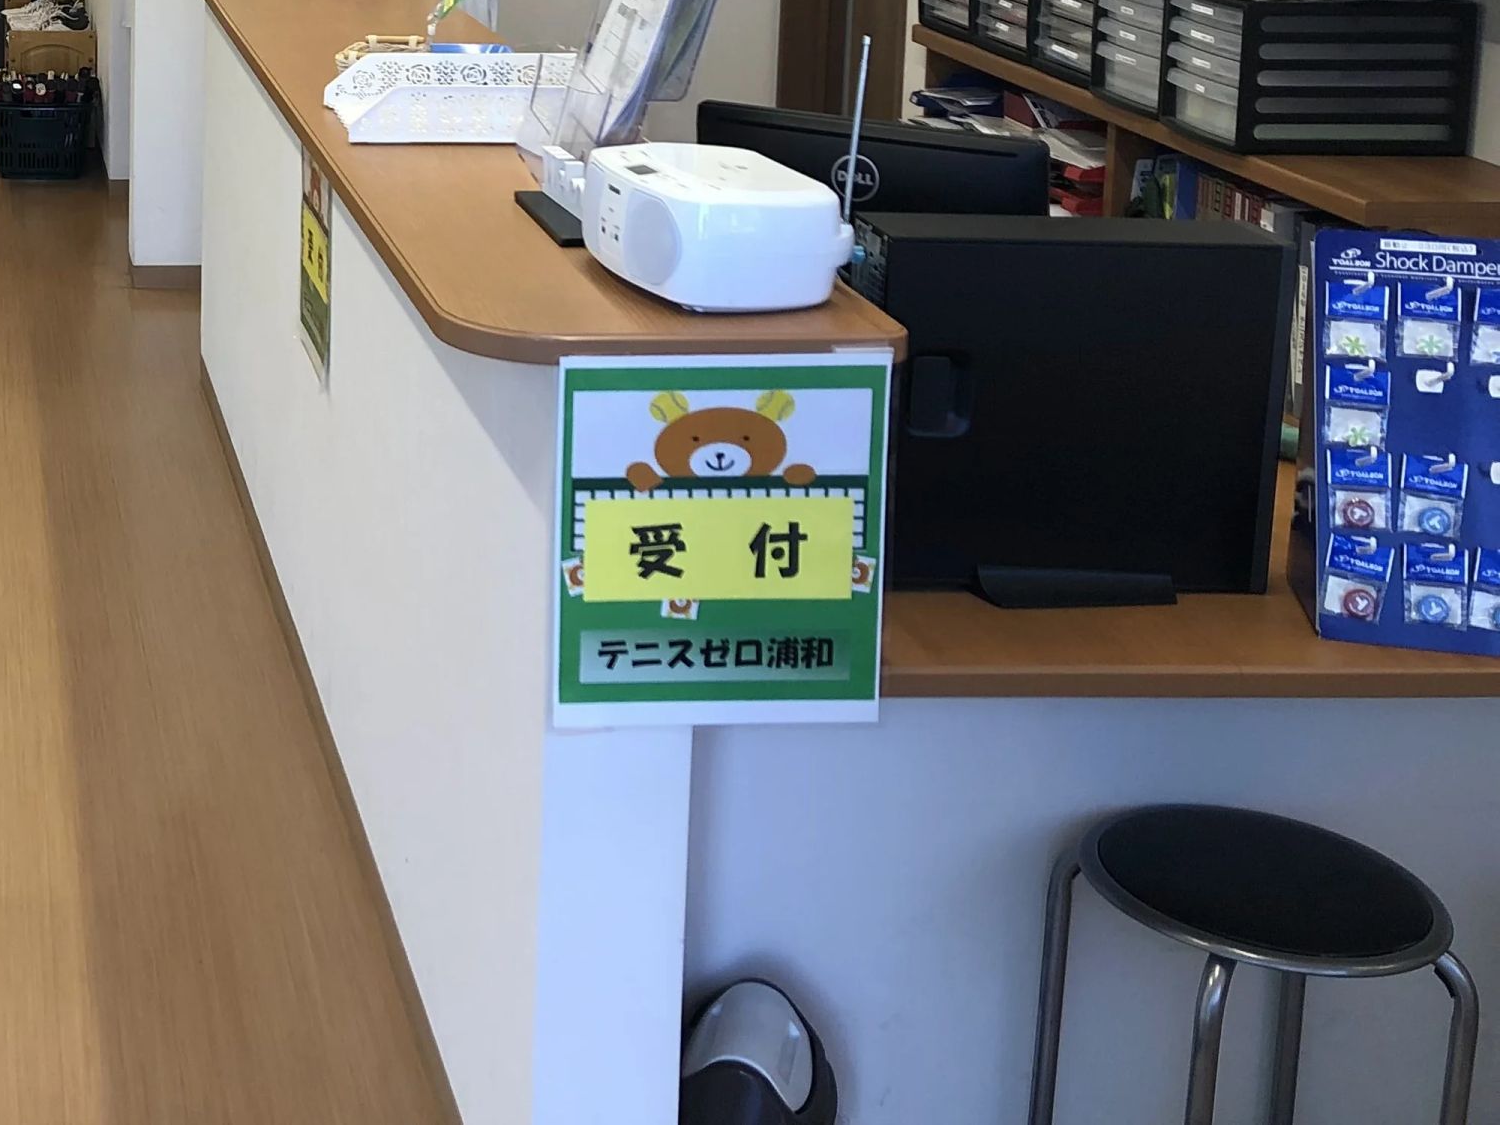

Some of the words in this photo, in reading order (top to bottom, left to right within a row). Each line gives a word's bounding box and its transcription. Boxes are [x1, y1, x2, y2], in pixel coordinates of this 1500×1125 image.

[837, 169, 874, 185] DLL
[1331, 257, 1372, 268] TOALSON
[1375, 251, 1429, 272] Shock
[629, 521, 809, 580] 受付
[598, 636, 835, 671] テニスゼロ浦和
